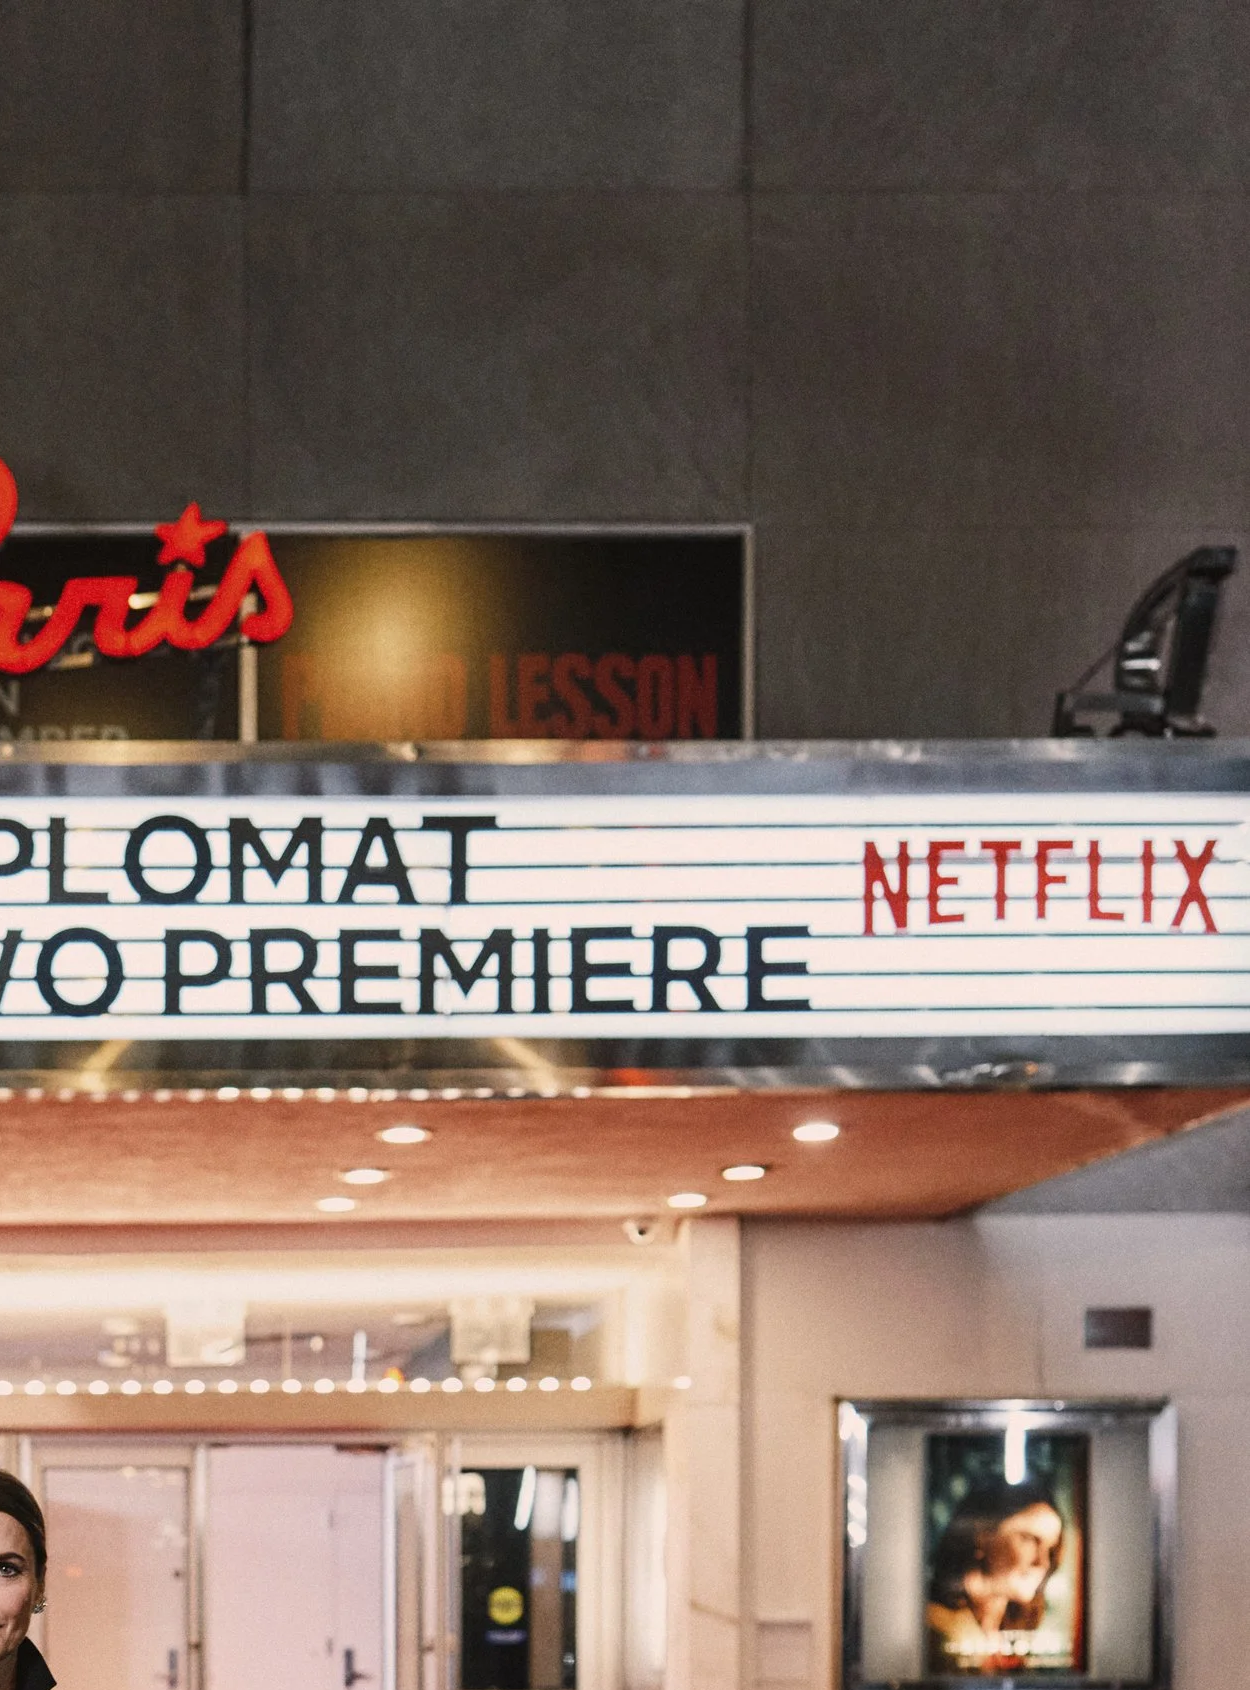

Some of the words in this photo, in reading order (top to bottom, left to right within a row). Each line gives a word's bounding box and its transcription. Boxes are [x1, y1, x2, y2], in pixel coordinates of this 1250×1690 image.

[489, 653, 717, 740] LESSON
[863, 840, 1218, 934] NETFLIX
[164, 926, 811, 1017] PREMIERE
